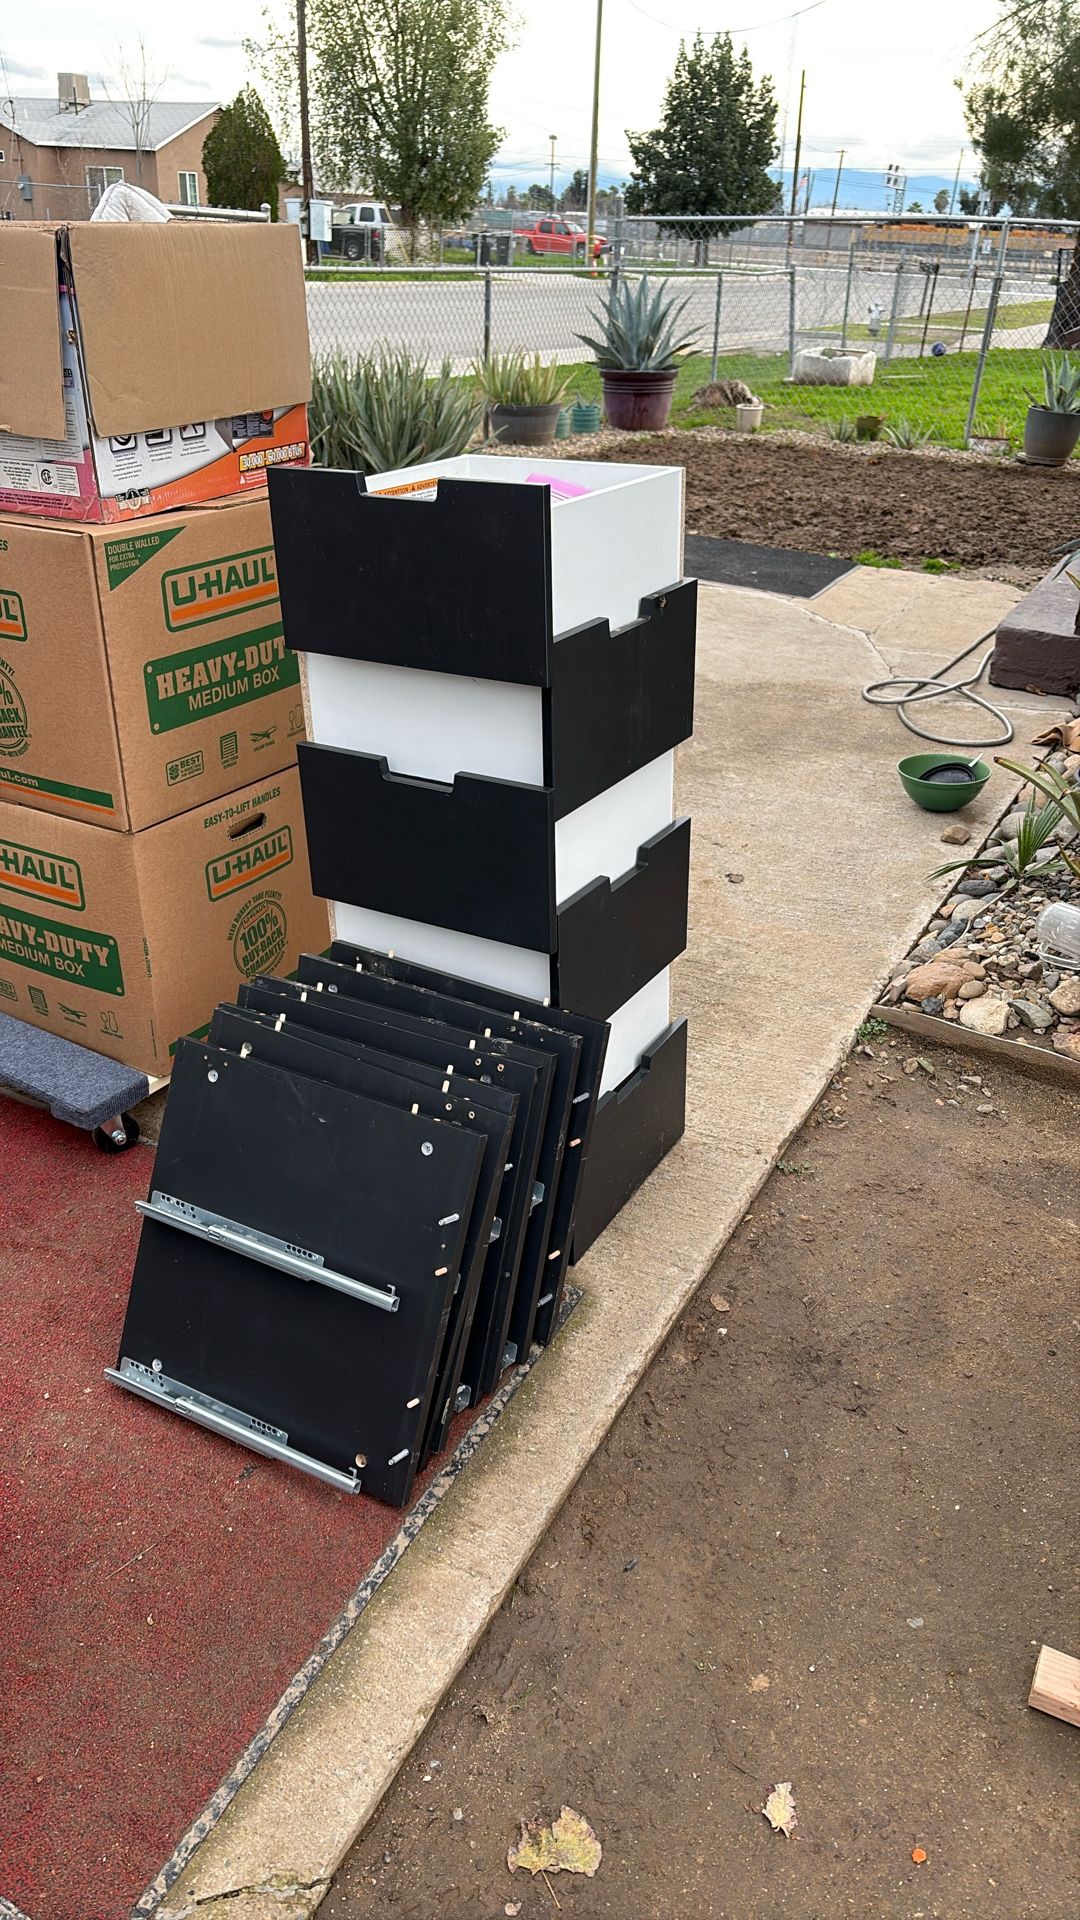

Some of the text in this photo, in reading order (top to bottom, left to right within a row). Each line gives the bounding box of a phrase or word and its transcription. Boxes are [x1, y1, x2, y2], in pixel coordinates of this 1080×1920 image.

[107, 536, 160, 555] DOUBLE WALLED
[108, 552, 135, 563] FOR EXTRA
[109, 559, 139, 571] PROTECTION
[171, 557, 275, 606] U-HAUL
[156, 636, 296, 700] HEAVY-DUT
[188, 665, 280, 711] MEDIUM BOX
[180, 754, 201, 769] BEST
[204, 786, 281, 829] EASY-TO-LIFT HANDLES
[212, 835, 288, 884] U-HAUL
[240, 908, 279, 952] 100%
[242, 925, 283, 968] BUY-BACK
[54, 957, 86, 977] BOX
